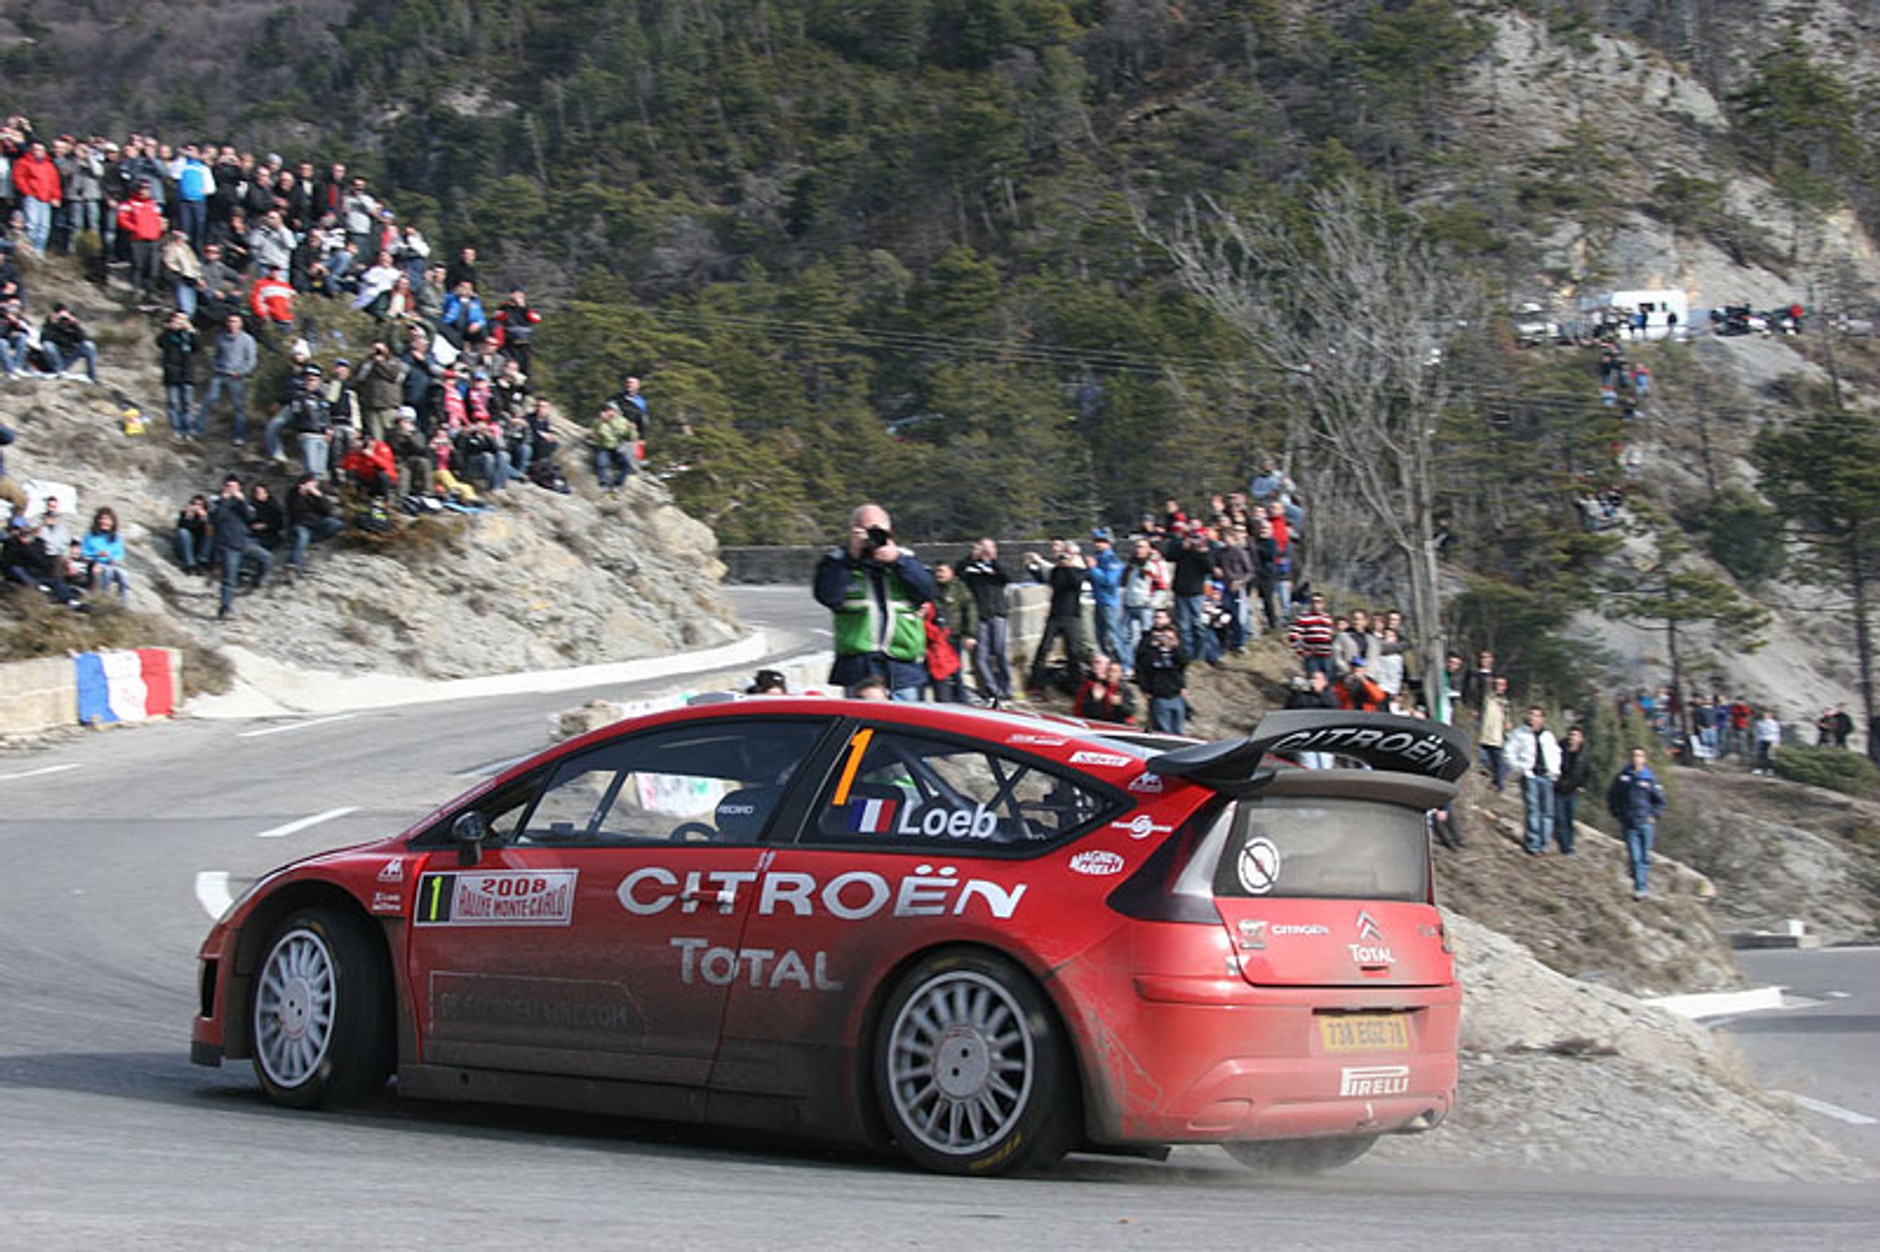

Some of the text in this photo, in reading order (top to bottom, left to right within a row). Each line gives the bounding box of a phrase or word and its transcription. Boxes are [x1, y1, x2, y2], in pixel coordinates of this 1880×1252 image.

[832, 728, 874, 806] 1
[1270, 728, 1452, 770] CITROËN
[898, 800, 998, 838] Loeb
[429, 876, 443, 921] 1
[481, 877, 547, 897] 2008
[616, 863, 1028, 920] CITROËN
[670, 937, 847, 991] TOTAL
[1348, 944, 1397, 963] TOTAL
[1340, 1064, 1409, 1096] PIRELLI
